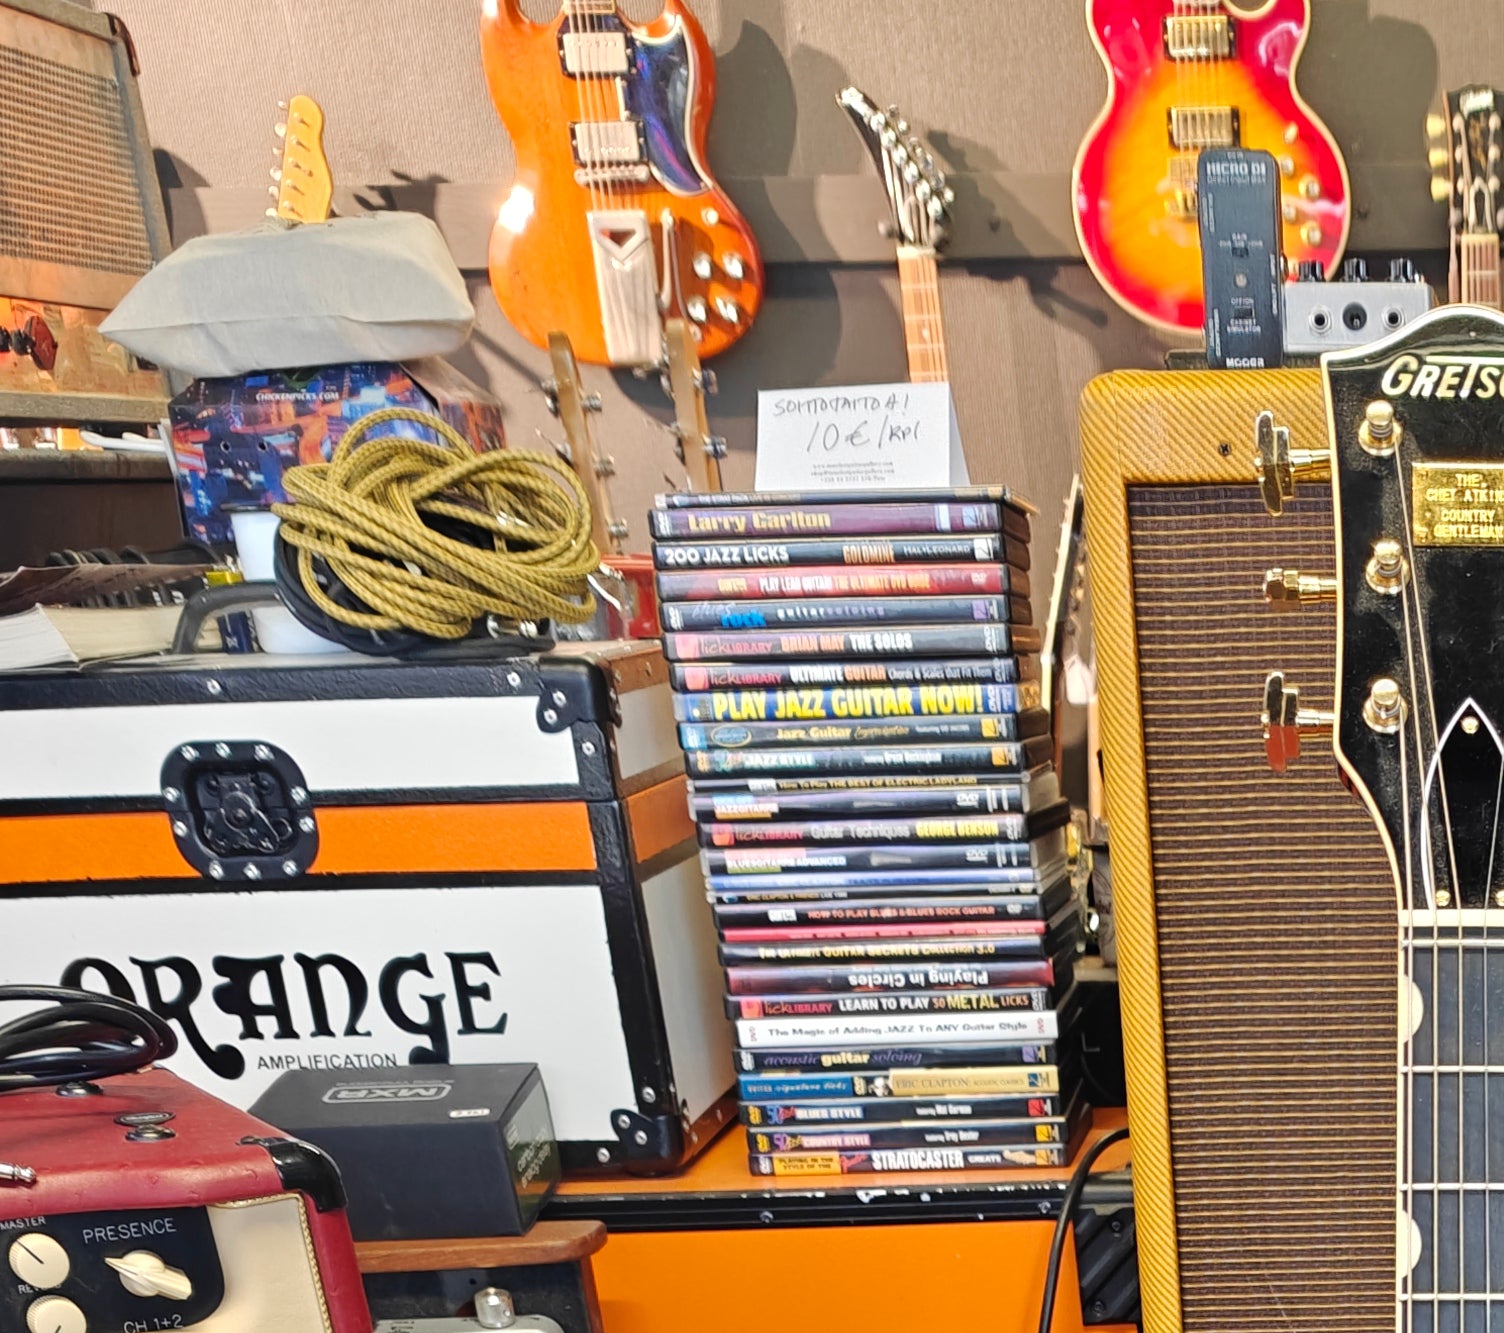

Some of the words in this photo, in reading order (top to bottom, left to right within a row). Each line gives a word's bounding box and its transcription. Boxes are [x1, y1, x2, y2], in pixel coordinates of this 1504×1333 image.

[1226, 357, 1265, 368] MOOER
[1426, 489, 1456, 502] CHET
[687, 512, 747, 534] Larry
[751, 510, 832, 531] Carlton
[1441, 509, 1496, 522] COUNTRY
[1433, 525, 1504, 539] GENTLEMAN
[664, 548, 700, 565] 200
[703, 546, 741, 564] JAZZ
[743, 545, 790, 564] LICKS
[758, 576, 779, 592] PLAY
[721, 608, 767, 629] rock
[780, 635, 818, 652] BRIAN
[819, 634, 845, 651] MAY
[849, 633, 873, 651] THE
[874, 632, 913, 650] SOLOS
[789, 665, 844, 683] ULTIMATE
[844, 664, 887, 681] GUITAR
[711, 690, 768, 721] PLAY
[774, 689, 827, 719] JAZZ
[830, 686, 915, 718] GUITAR
[919, 683, 985, 714] NOW!
[776, 727, 807, 740] Jazz
[809, 726, 853, 739] Guitar
[810, 826, 845, 840] Guitar
[850, 823, 911, 841] Techniques
[915, 821, 957, 838] GEORGE
[957, 820, 999, 836] BENSON
[808, 910, 831, 919] HOW
[832, 909, 845, 918] TO
[846, 908, 869, 918] PLAY
[869, 907, 899, 918] BLUES
[906, 906, 935, 917] BLUES
[936, 906, 961, 916] ROCK
[962, 905, 996, 916] GUITAR
[822, 945, 866, 958] GUITAR
[866, 944, 921, 957] SECRETS
[847, 971, 906, 989] Circles
[928, 967, 990, 987] Playing
[838, 997, 880, 1012] LEARN
[881, 997, 898, 1010] TO
[900, 995, 931, 1010] PLAY
[946, 992, 1000, 1010] METAL
[1000, 994, 1030, 1008] LICKS
[768, 1028, 789, 1037] The
[791, 1027, 826, 1037] Magic
[828, 1027, 840, 1036] of
[843, 1026, 882, 1038] Adding
[935, 1024, 960, 1033] ANY
[257, 1052, 398, 1070] AMPLIFICATION
[763, 1053, 819, 1067] acoustic
[820, 1051, 871, 1068] guitar
[872, 1050, 923, 1066] soloing
[336, 1086, 439, 1100] MXR
[871, 1150, 965, 1171] STRATOCASTER
[0, 1215, 46, 1231] MASTER
[82, 1217, 177, 1244] PRESENCE
[154, 1313, 184, 1331] 1+2
